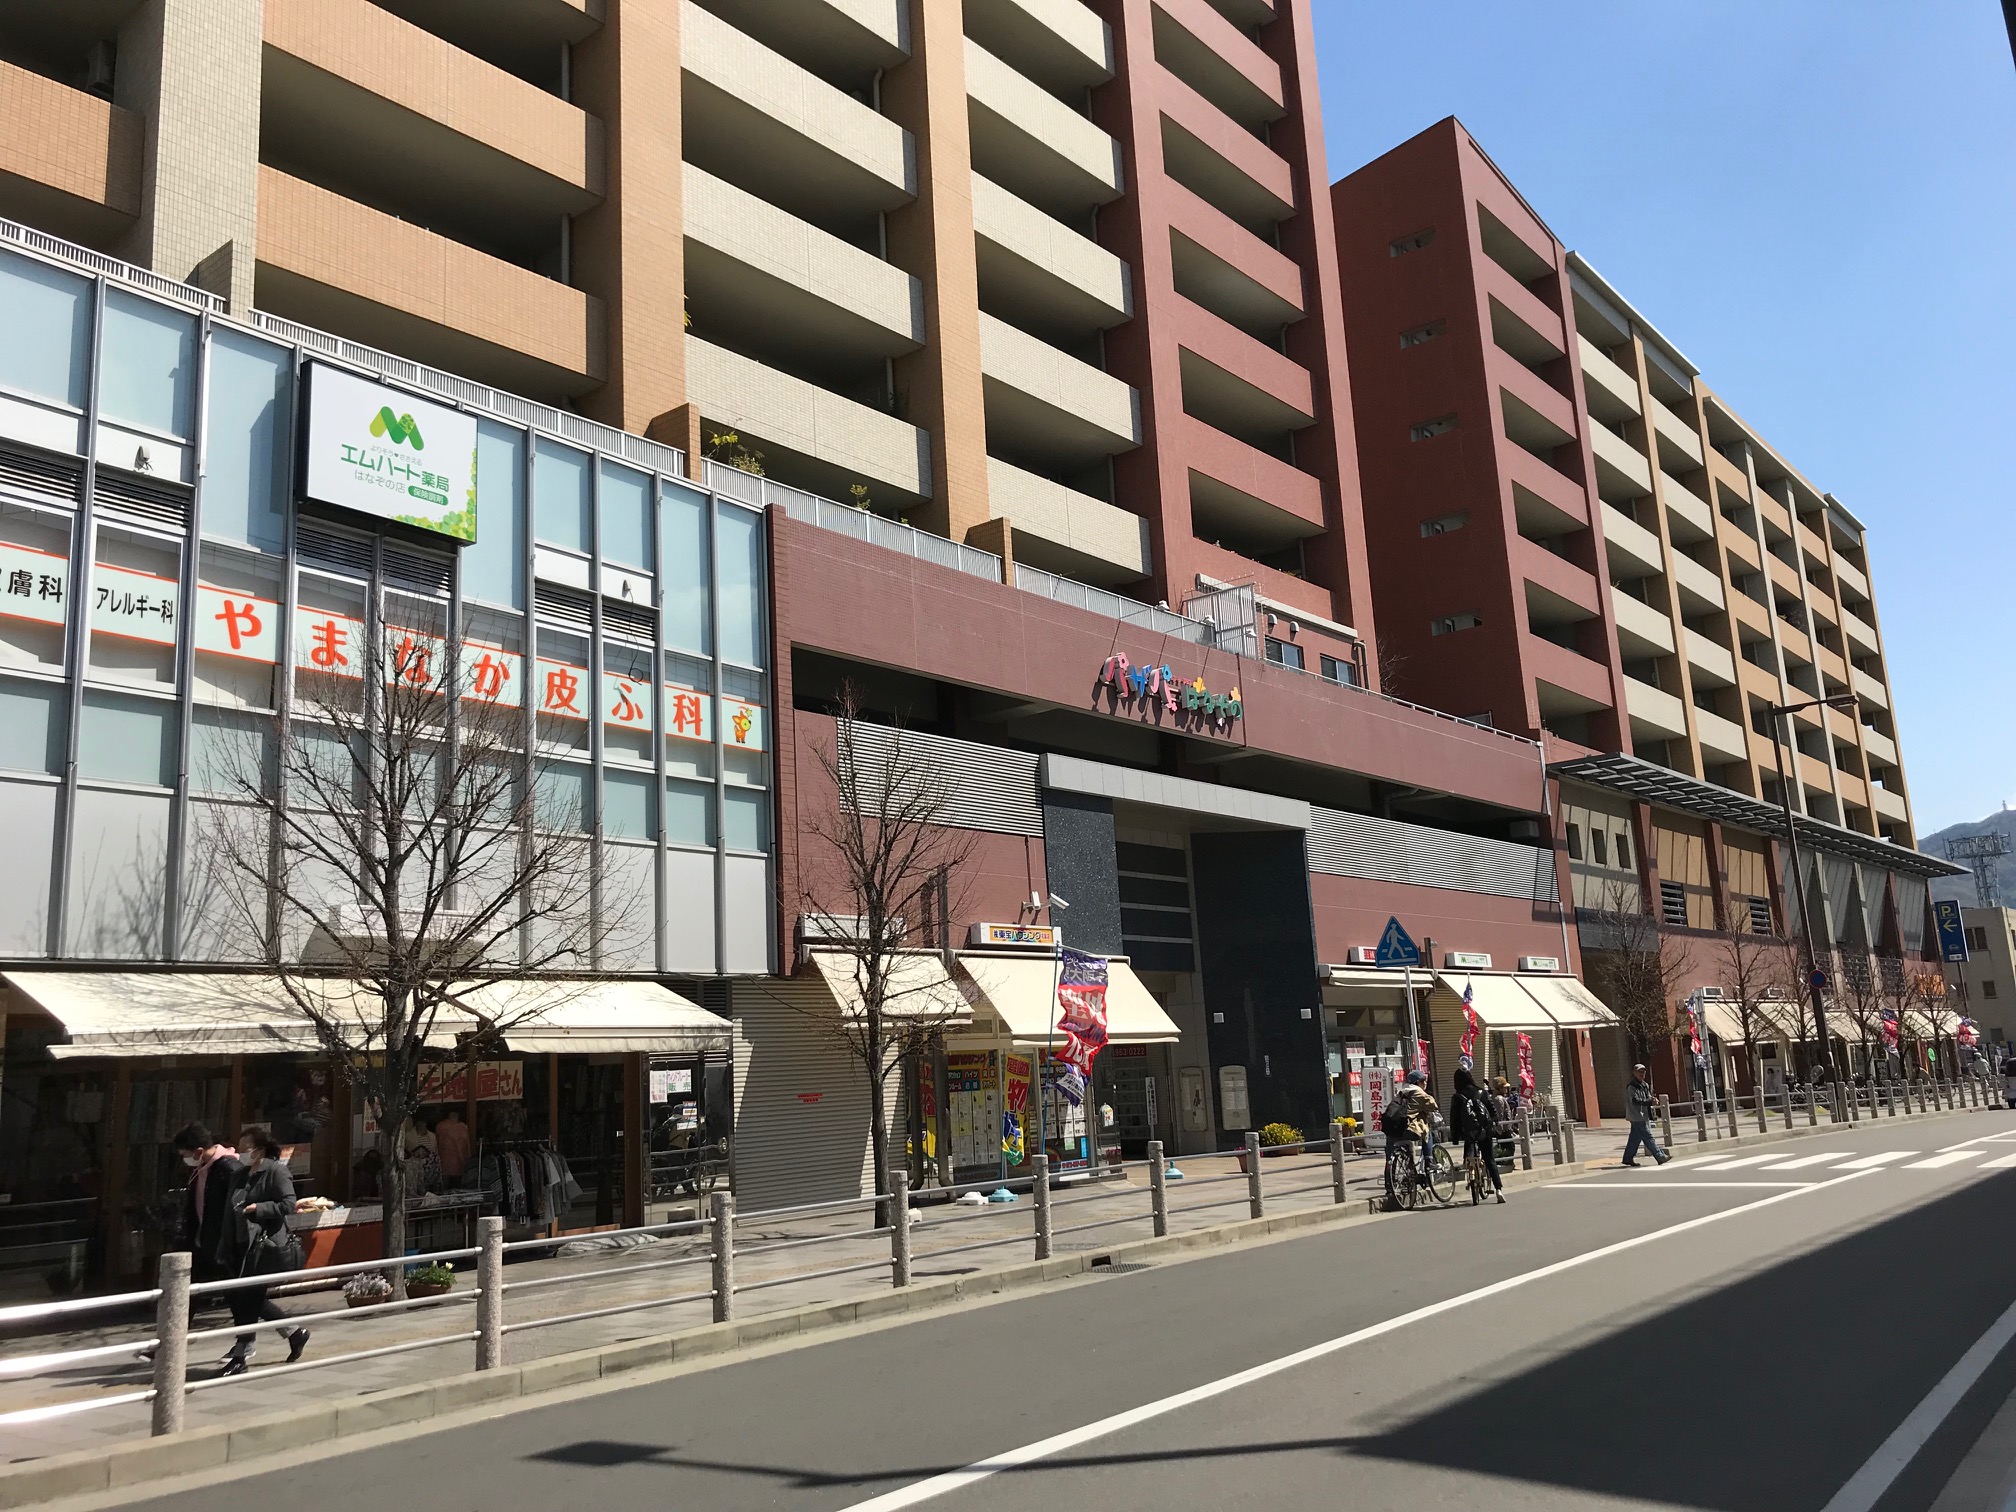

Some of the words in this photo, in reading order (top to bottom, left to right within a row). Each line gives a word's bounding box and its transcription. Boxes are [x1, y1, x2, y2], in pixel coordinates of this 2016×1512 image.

[341, 443, 449, 493] エムハート薬局
[354, 469, 406, 495] はなぞの店
[0, 567, 63, 604] 膚科
[96, 587, 174, 625] アレルギー科
